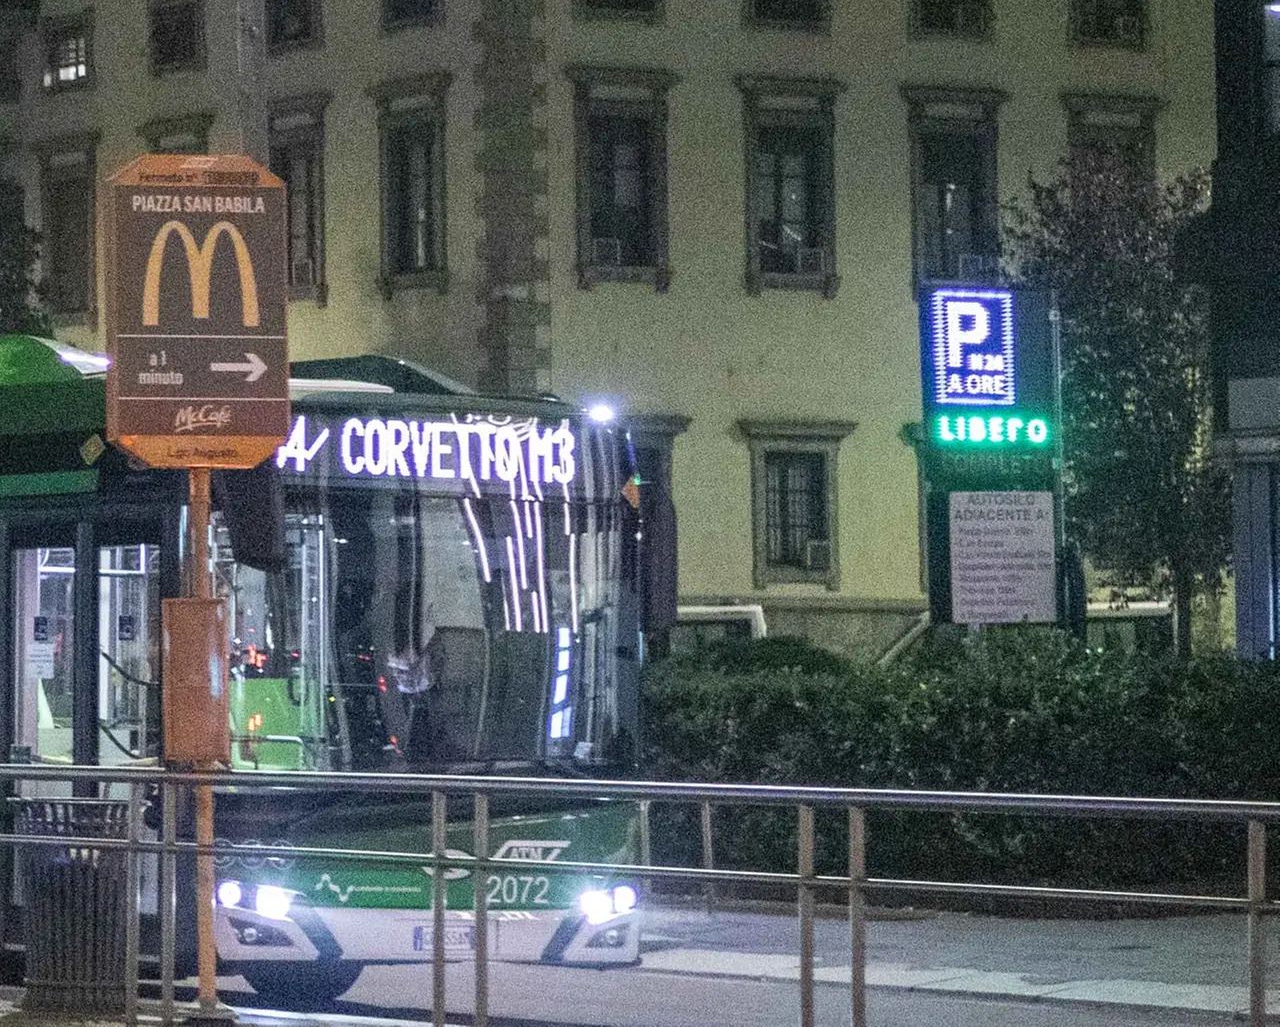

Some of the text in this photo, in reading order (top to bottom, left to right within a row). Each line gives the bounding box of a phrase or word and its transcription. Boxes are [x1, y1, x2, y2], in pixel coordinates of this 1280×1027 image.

[132, 195, 265, 214] PIAZZA SAN BABILA
[946, 301, 991, 368] P
[138, 369, 184, 385] minuto
[947, 374, 1007, 395] A ORE
[341, 417, 520, 482] CORVETTO
[529, 423, 576, 484] M3
[968, 493, 1035, 506] AUTOSILO
[954, 509, 1031, 521] ADIACENTE
[485, 874, 549, 904] 2072
